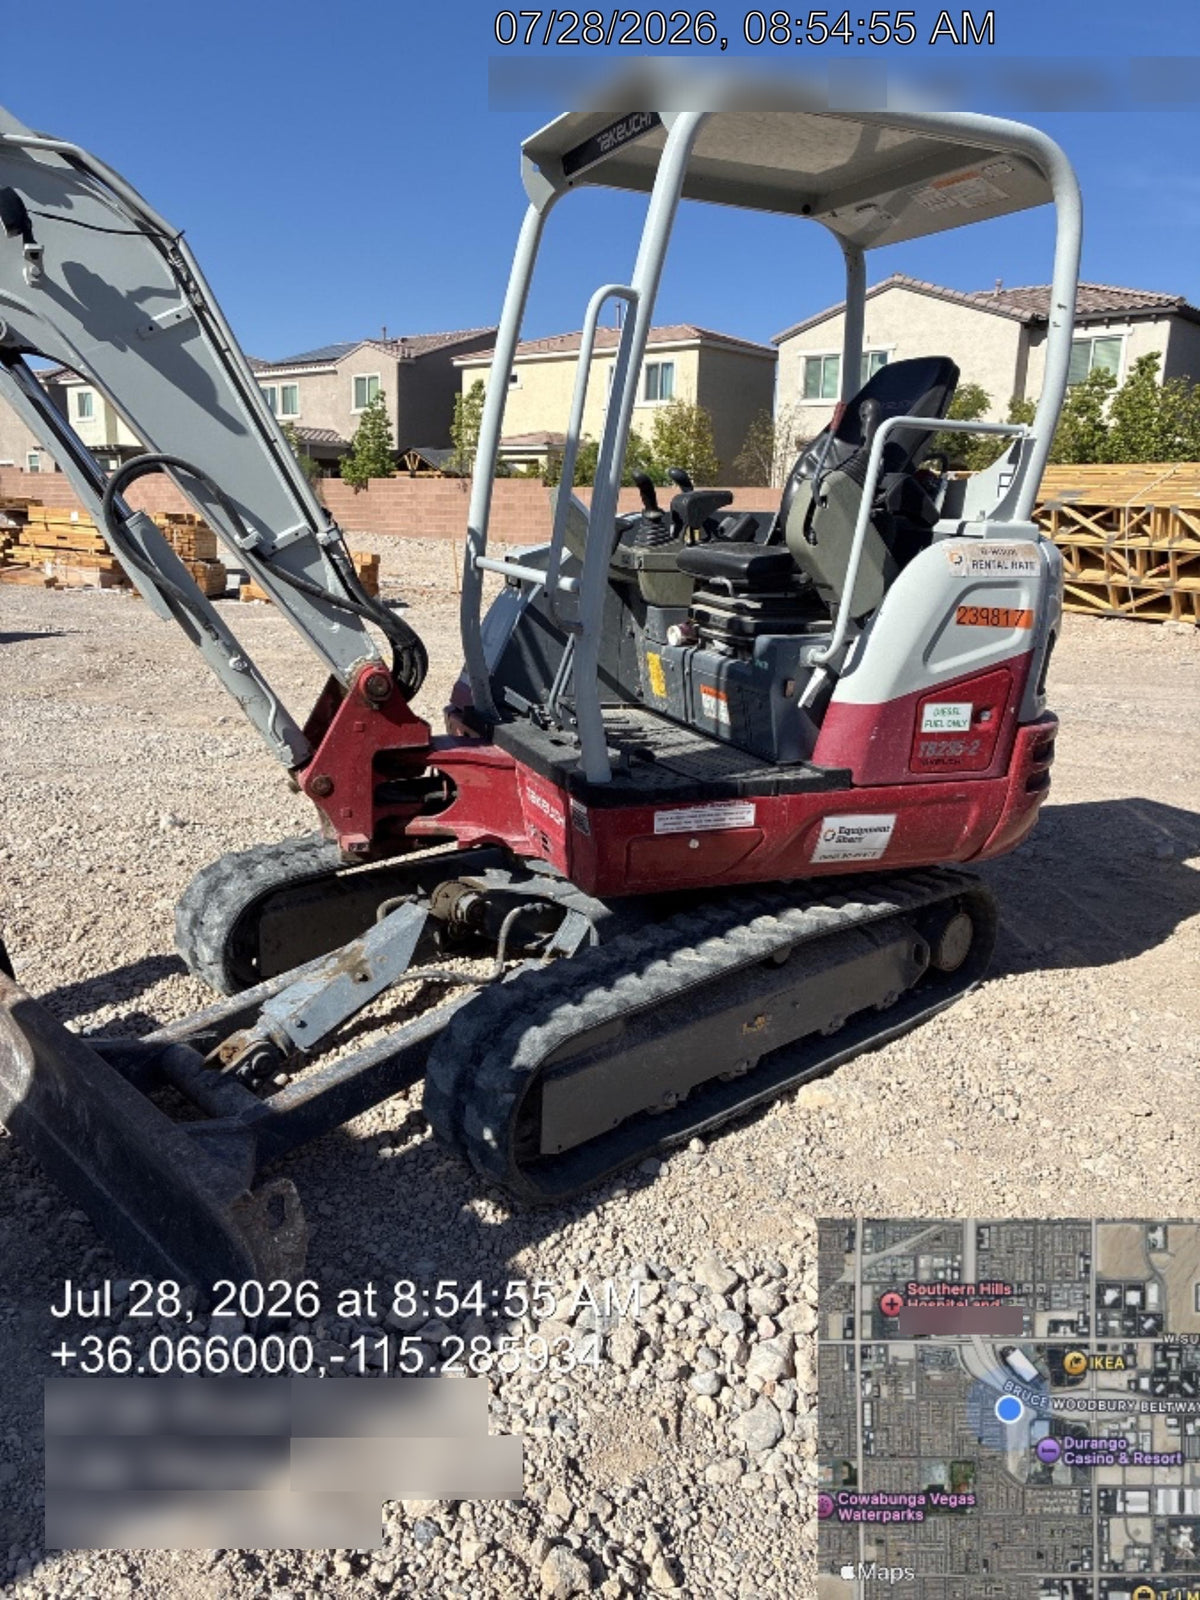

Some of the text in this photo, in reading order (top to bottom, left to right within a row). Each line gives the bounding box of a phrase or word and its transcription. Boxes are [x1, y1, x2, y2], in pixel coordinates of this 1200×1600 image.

[972, 560, 1009, 570] RENTAL
[957, 606, 1025, 627] 239817
[924, 719, 968, 728] FUEL ONLY
[838, 825, 891, 836] Equipment
